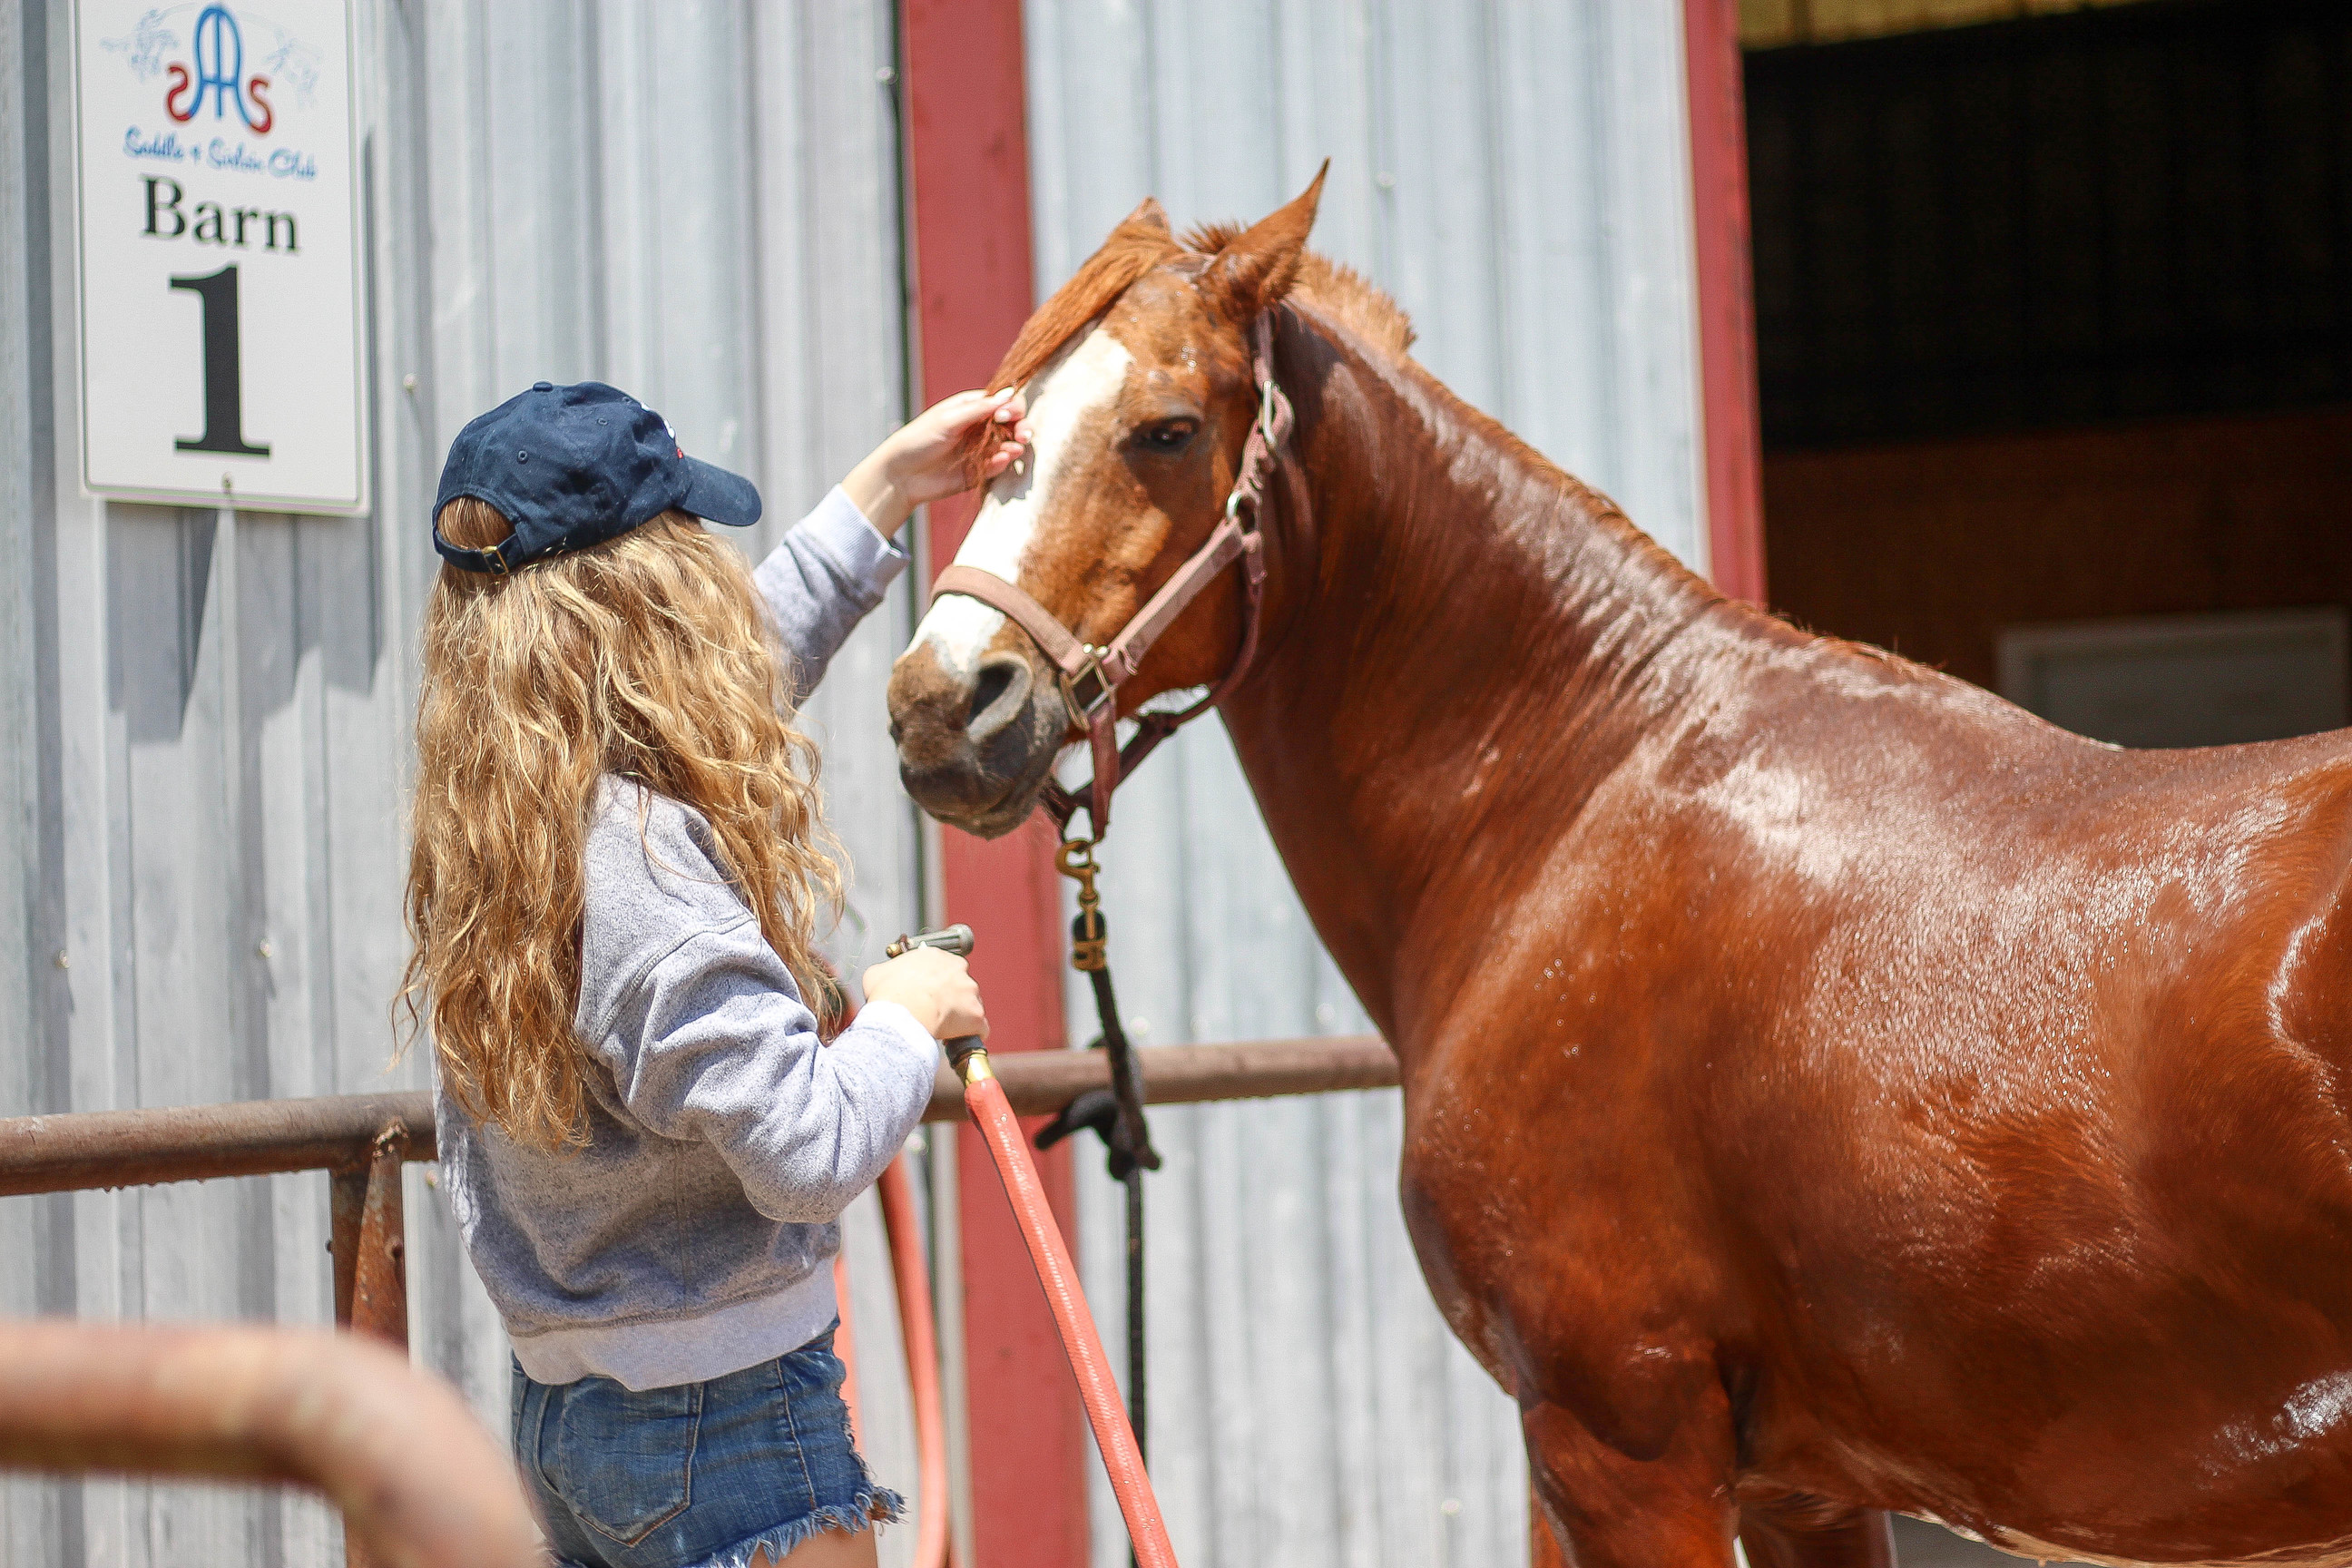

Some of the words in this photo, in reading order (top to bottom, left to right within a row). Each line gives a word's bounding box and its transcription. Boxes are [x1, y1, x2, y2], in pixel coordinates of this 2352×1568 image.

[269, 148, 318, 181] Club
[140, 174, 300, 253] Barn
[169, 264, 271, 458] 1
